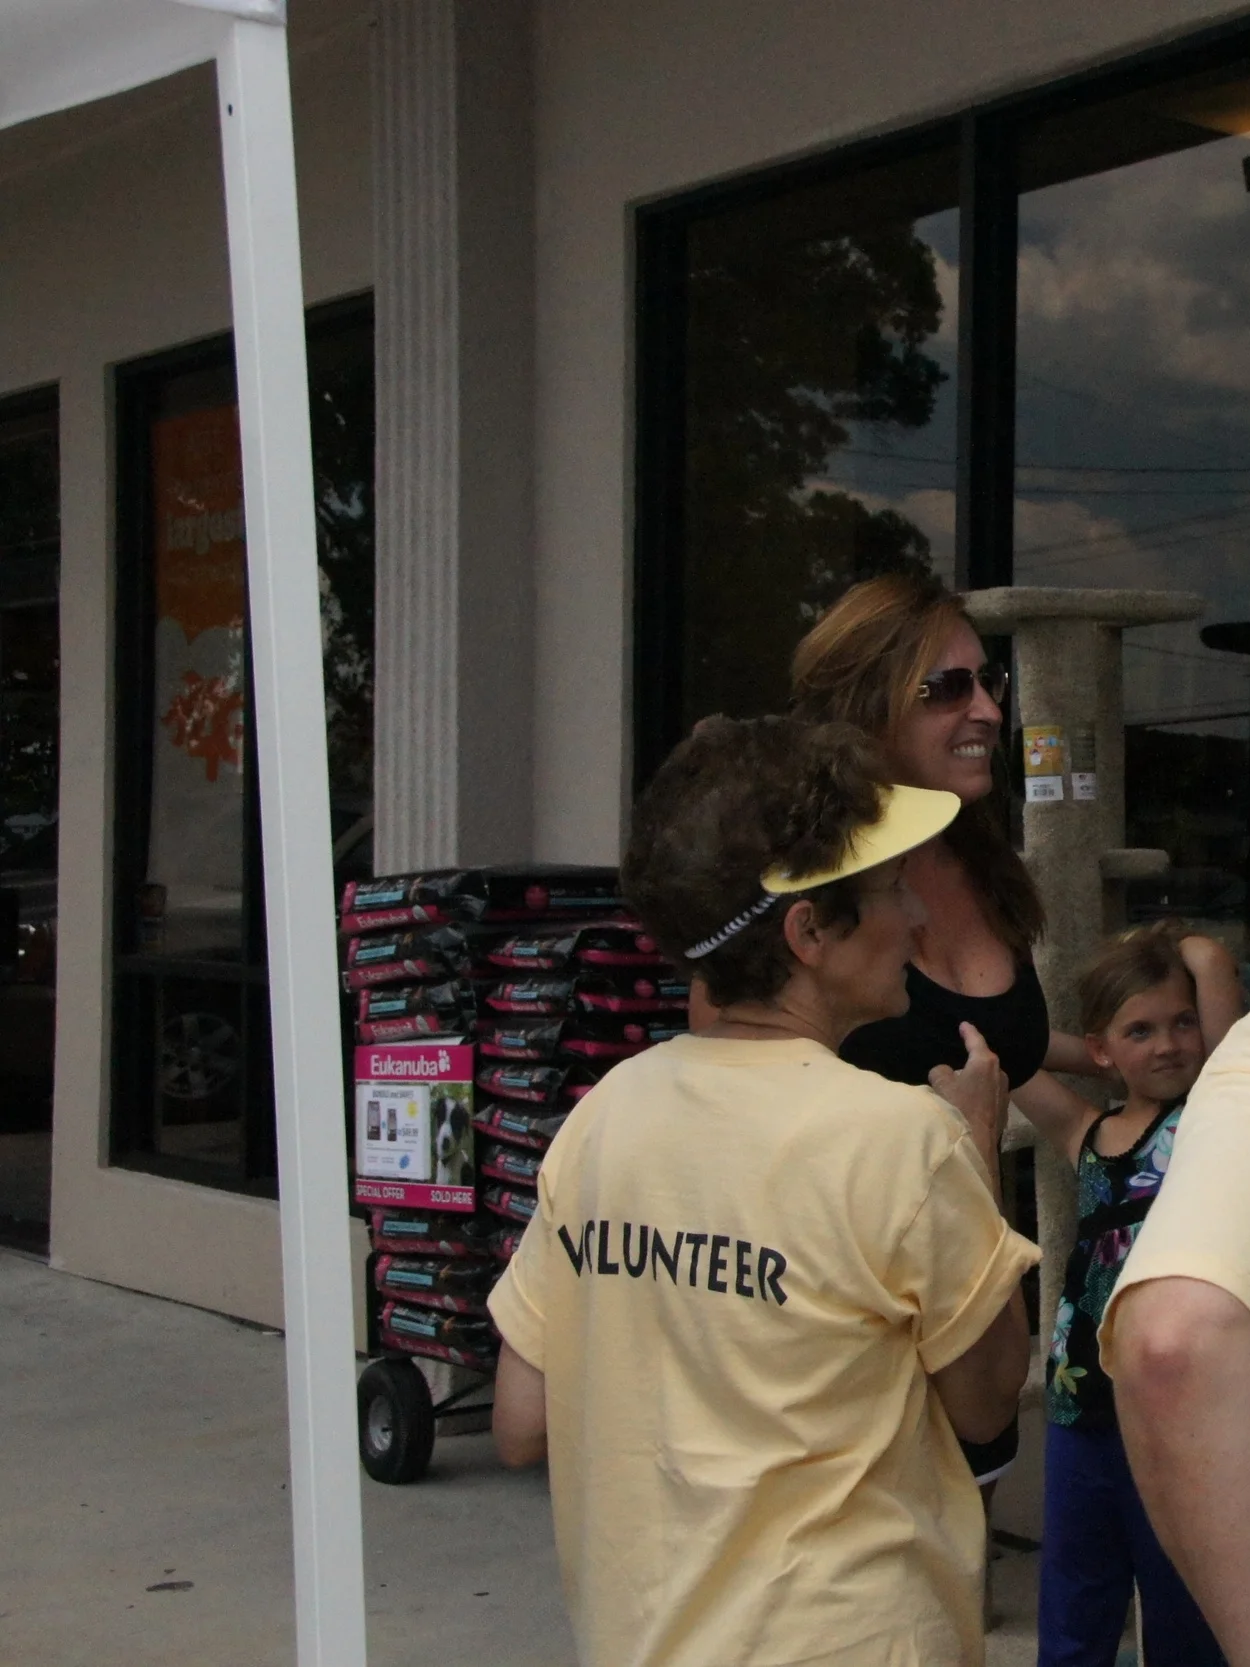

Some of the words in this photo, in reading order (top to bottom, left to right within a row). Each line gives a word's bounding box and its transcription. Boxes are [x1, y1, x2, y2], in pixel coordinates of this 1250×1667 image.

[370, 1054, 439, 1076] Eukanuba
[355, 1184, 382, 1198] SPECIAL
[383, 1186, 406, 1200] OFFER
[430, 1189, 451, 1203] SOLD
[452, 1192, 473, 1205] HERE
